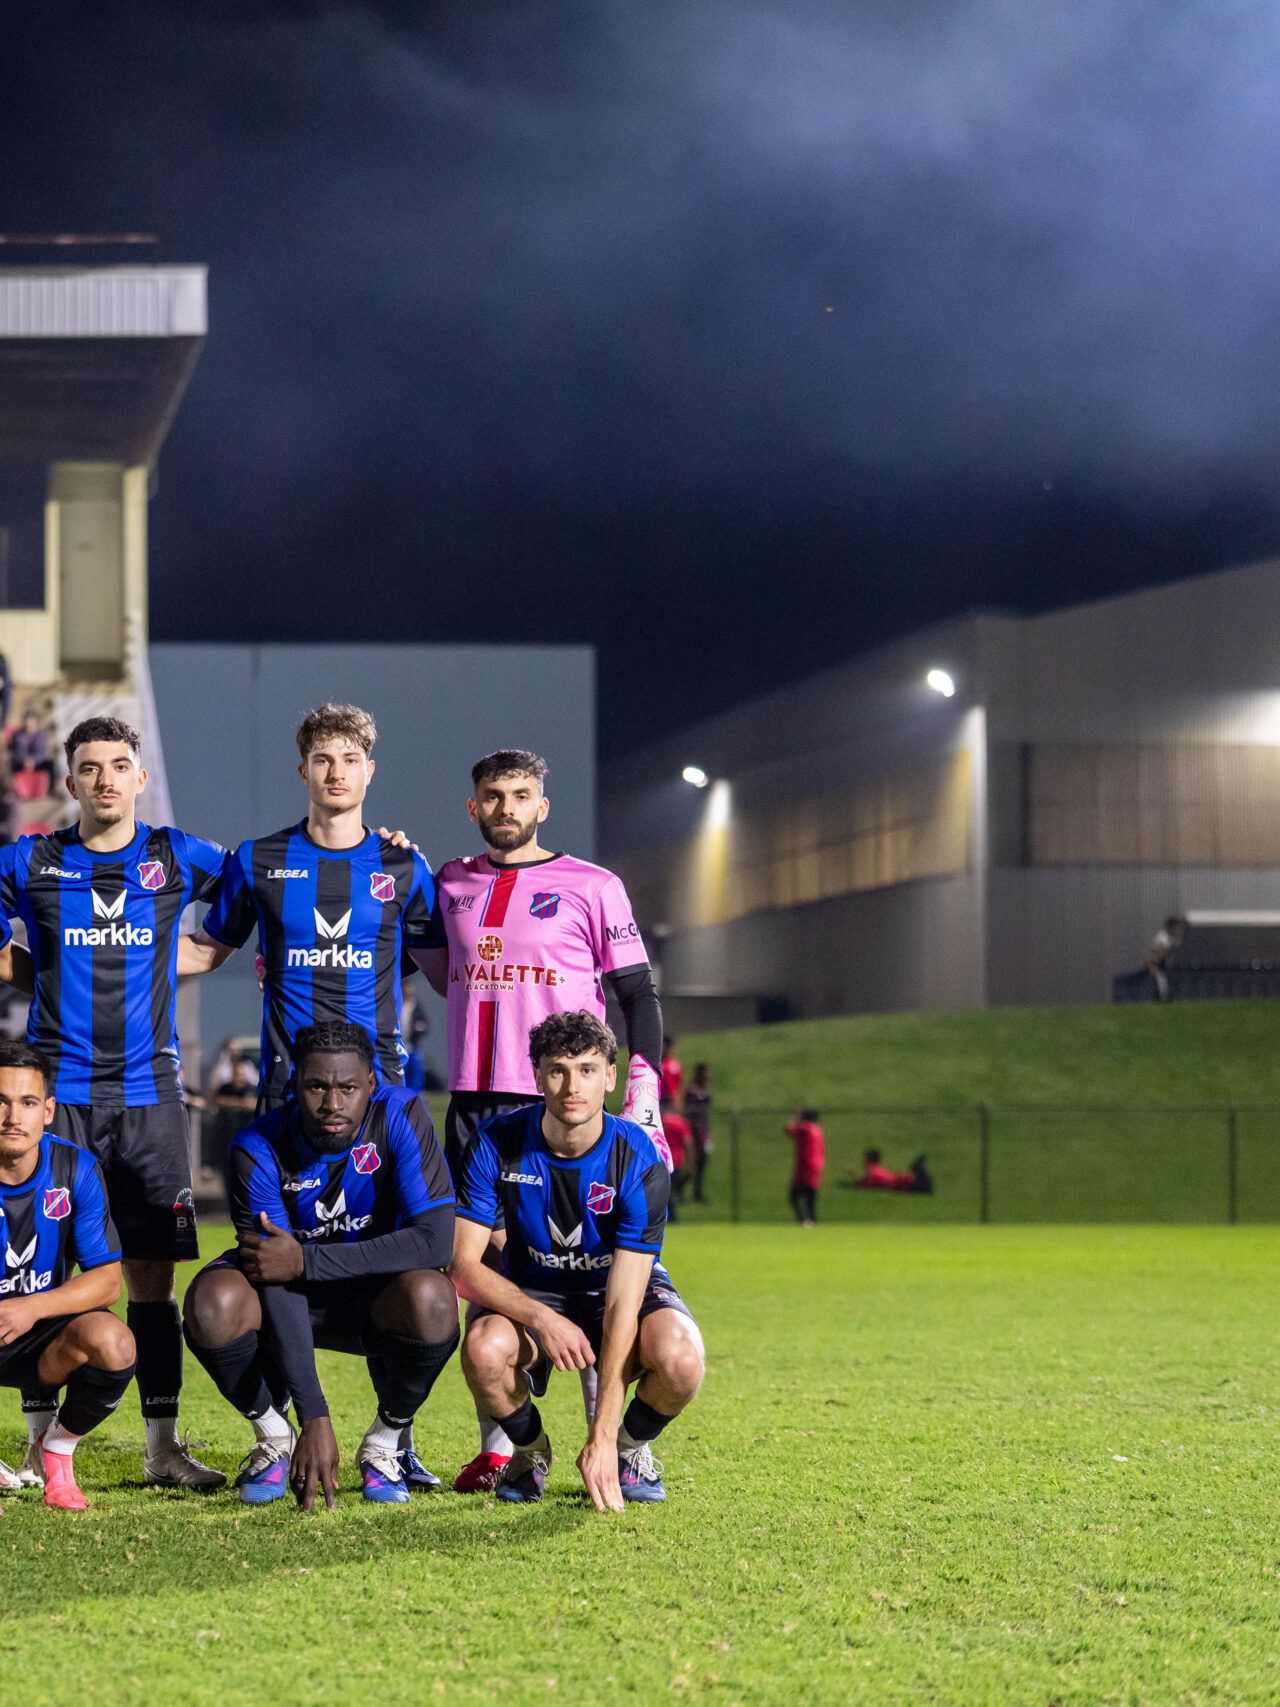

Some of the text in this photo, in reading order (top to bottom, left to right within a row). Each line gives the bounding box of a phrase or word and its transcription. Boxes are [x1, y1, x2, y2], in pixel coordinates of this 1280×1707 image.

[40, 866, 82, 880] LEGEA
[267, 869, 309, 879] LEGEA
[64, 922, 153, 946] markka
[287, 944, 373, 968] markka
[464, 963, 557, 987] VALETTE
[466, 983, 515, 991] BLACKTOWN
[501, 1171, 544, 1187] LEGEA
[528, 1246, 614, 1271] markka
